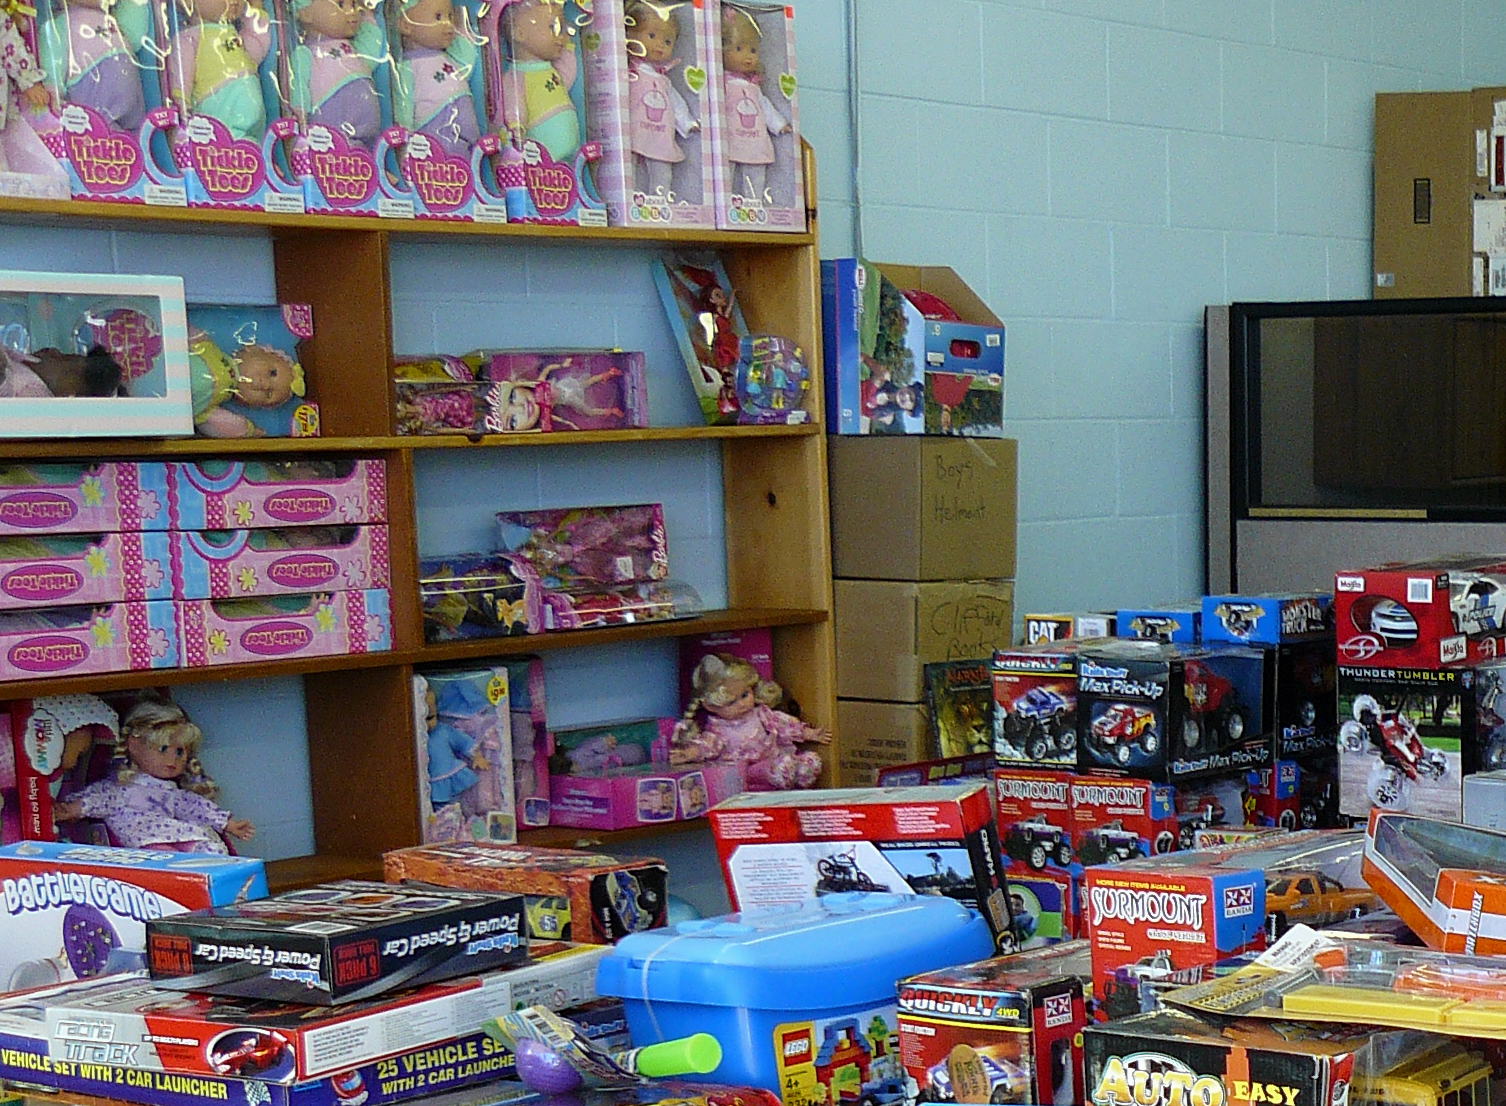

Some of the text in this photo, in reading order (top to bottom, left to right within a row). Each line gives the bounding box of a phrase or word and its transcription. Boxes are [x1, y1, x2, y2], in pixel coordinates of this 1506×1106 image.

[71, 136, 135, 163] Tickle
[196, 146, 258, 173] Tickle
[83, 163, 130, 184] Toes
[315, 154, 373, 180] Tickle
[414, 160, 468, 186] Tickle
[326, 178, 367, 199] Toes
[424, 183, 463, 205] Toes
[1029, 621, 1058, 645] CAT
[1339, 667, 1456, 682] THUNDERTUMBLER
[1079, 677, 1164, 700] Max Pick-Up
[1092, 886, 1208, 930] SURMOUNT
[410, 913, 521, 955] Power Speed
[196, 943, 321, 970] Power Car
[899, 989, 997, 1018] QUICKLY
[783, 1037, 810, 1056] LEGO
[2, 1050, 229, 1100] VEHICLE WITH 2 CAR LAUNCHER
[377, 1058, 401, 1080] 25
[404, 1045, 479, 1075] VEHICLE
[382, 1067, 456, 1097] WITH CAR
[785, 1079, 801, 1092] 4+
